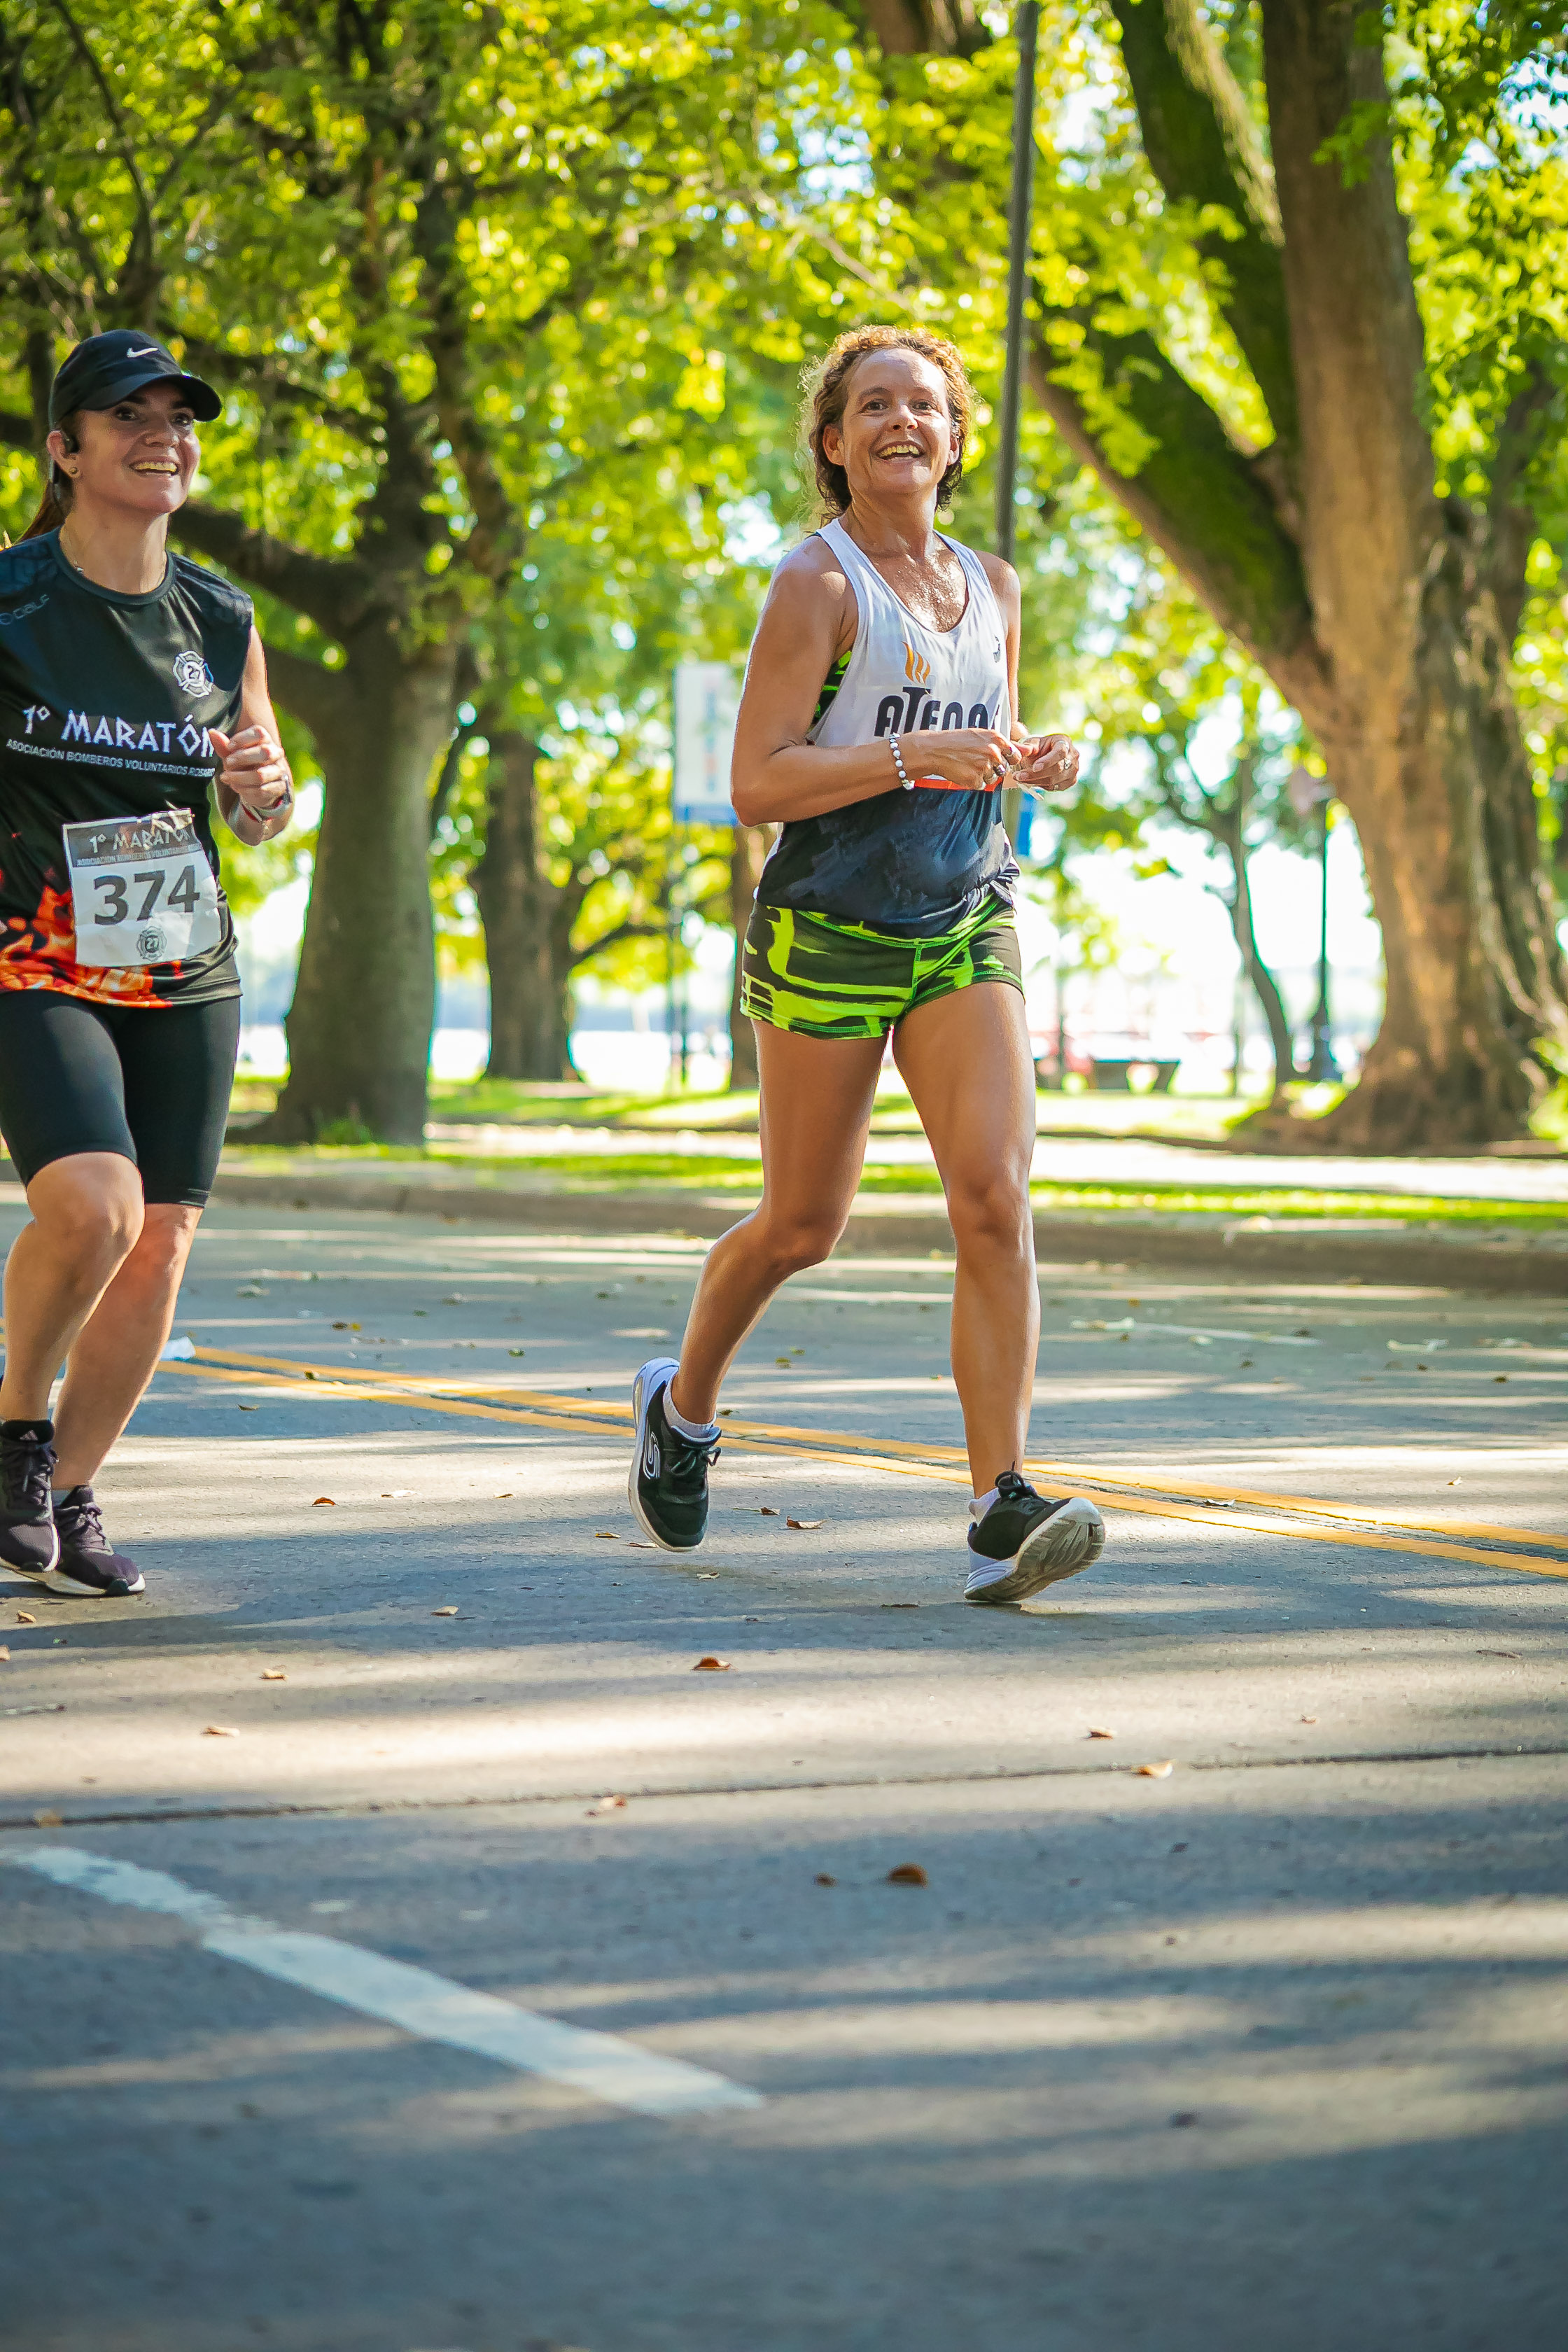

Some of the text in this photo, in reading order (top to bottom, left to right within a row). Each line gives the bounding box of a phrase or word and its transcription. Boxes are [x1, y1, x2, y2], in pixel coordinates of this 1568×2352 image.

[60, 708, 215, 757] MARATÓN
[66, 751, 123, 768] BOMBEROS
[125, 759, 188, 776] VOLUNTARIOS
[93, 864, 201, 925] 374
